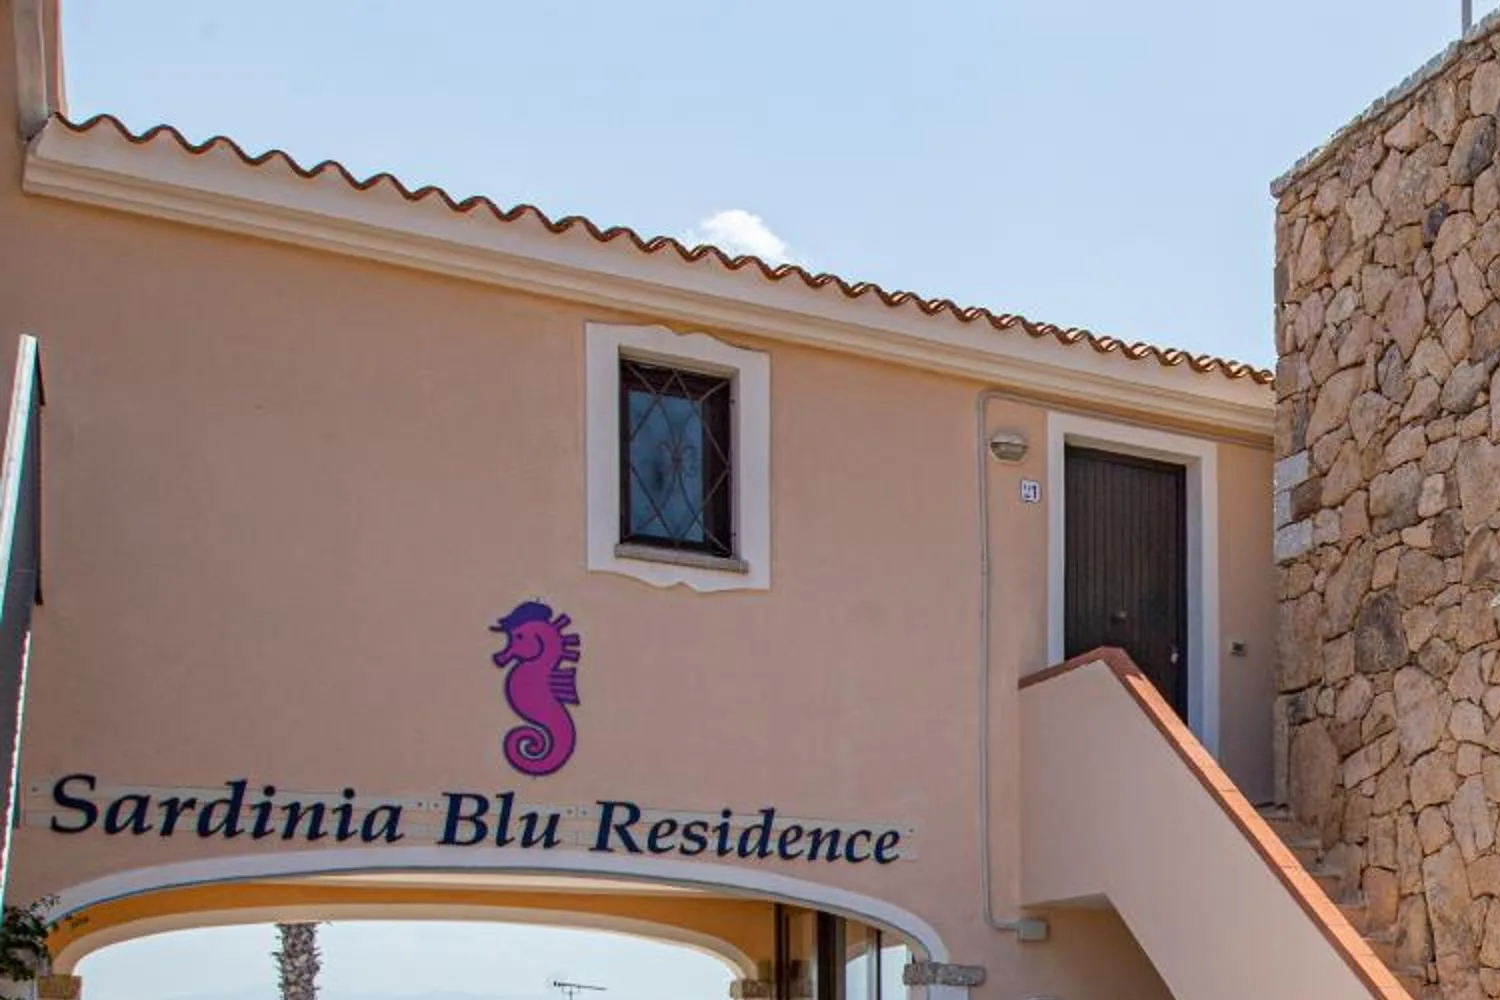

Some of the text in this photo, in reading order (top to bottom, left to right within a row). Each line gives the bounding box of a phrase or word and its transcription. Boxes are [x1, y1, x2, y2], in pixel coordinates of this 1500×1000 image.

[50, 773, 901, 865] Sardinia Blu Residence
